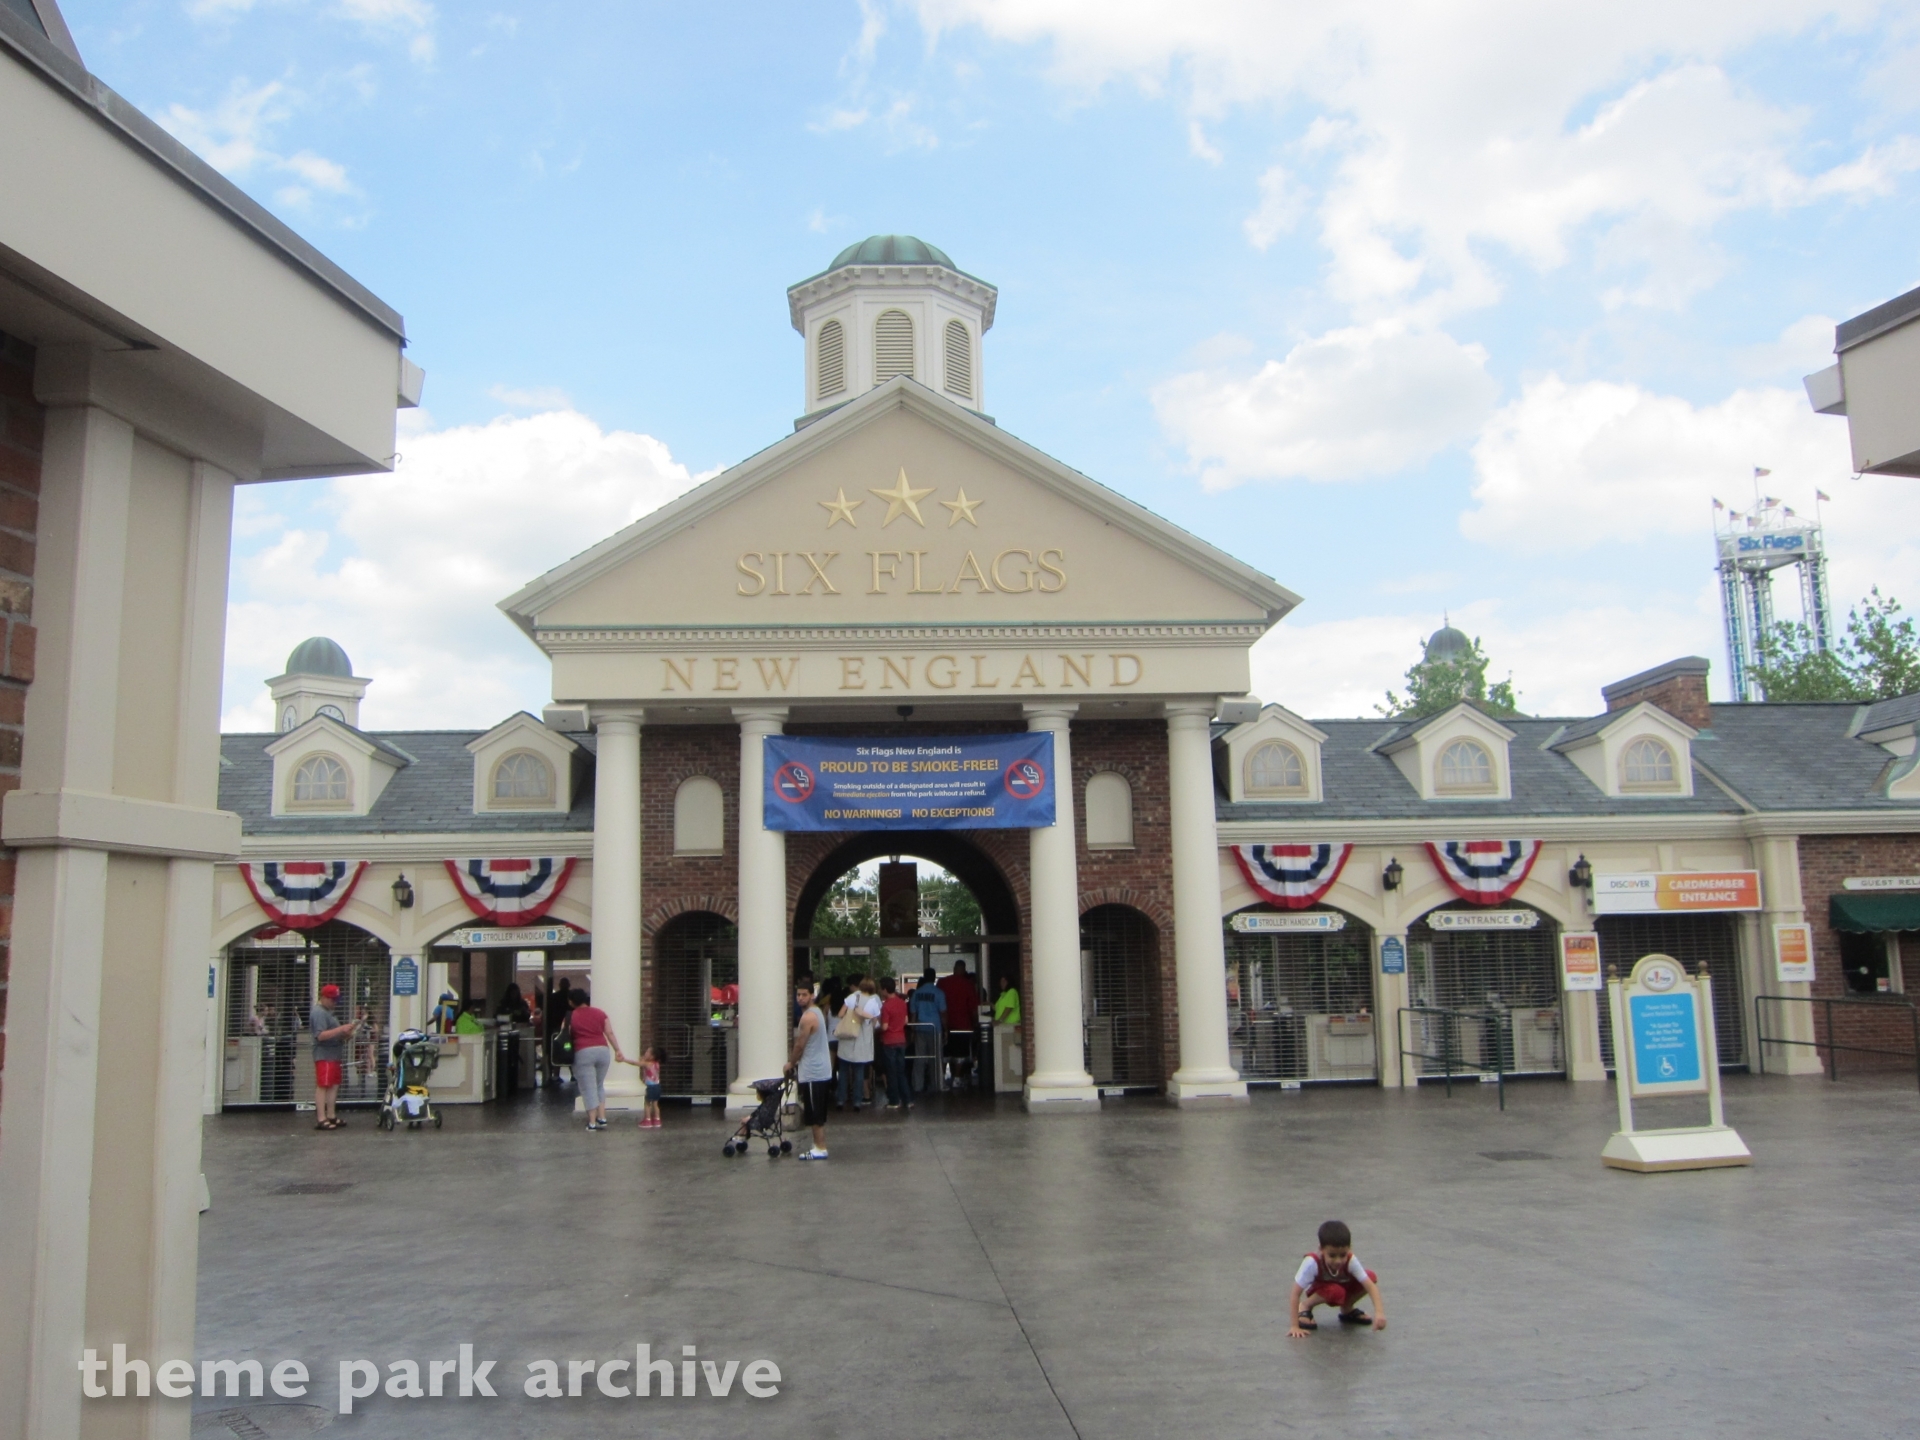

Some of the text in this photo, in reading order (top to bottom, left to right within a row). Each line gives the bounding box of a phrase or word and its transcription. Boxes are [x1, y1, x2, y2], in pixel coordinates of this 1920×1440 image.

[1738, 535, 1804, 551] Six Flags
[736, 548, 1068, 596] SIX FLAGS
[660, 653, 1144, 692] NEW ENGLAND
[856, 746, 962, 757] Six Flags New England is
[820, 759, 999, 773] PROUD TO BE SMOKE-FREE!
[899, 782, 933, 790] designated
[866, 791, 890, 799] ejection
[824, 807, 995, 818] NO WARNINGS! NO EXCEPTIONS!
[1610, 879, 1745, 889] DISCOVER CARDMEMBER
[1680, 892, 1737, 902] ENTRANCE
[1258, 917, 1319, 927] STROLLER HANDICAP
[1457, 915, 1510, 925] ENTRANCE
[483, 931, 545, 941] STROLLER HANDICAP
